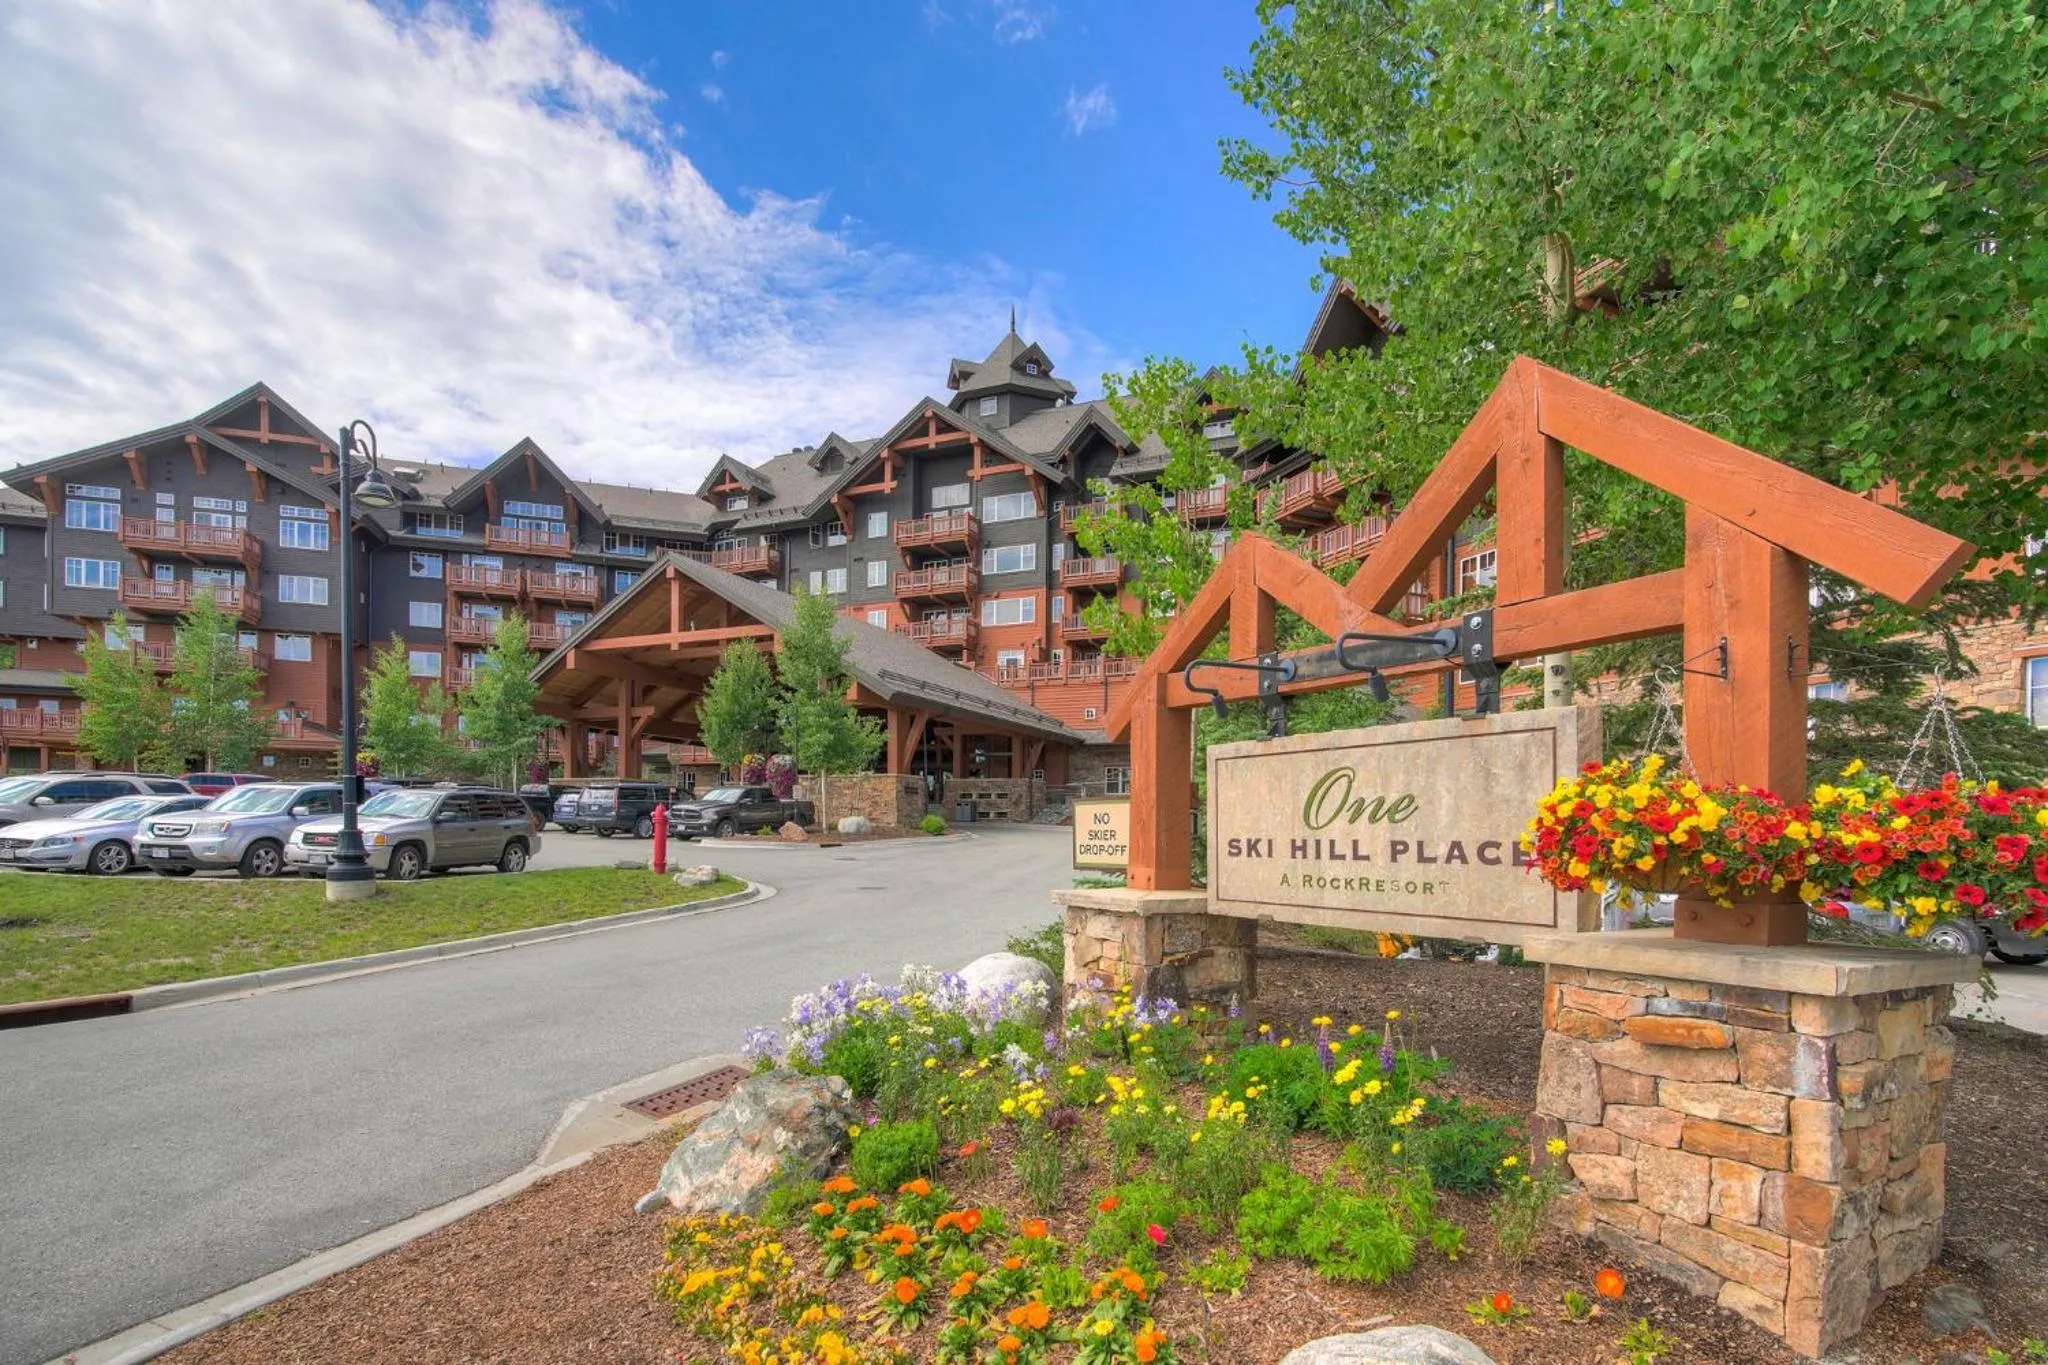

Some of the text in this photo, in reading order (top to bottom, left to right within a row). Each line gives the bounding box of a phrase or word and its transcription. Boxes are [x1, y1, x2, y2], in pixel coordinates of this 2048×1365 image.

[1303, 766, 1420, 831] One
[1093, 812, 1111, 825] NO
[1087, 829, 1117, 841] SKIER
[1079, 844, 1127, 857] DROP-OFF
[1227, 837, 1274, 858] SKI
[1290, 839, 1370, 861] HILL
[1280, 873, 1291, 887] A
